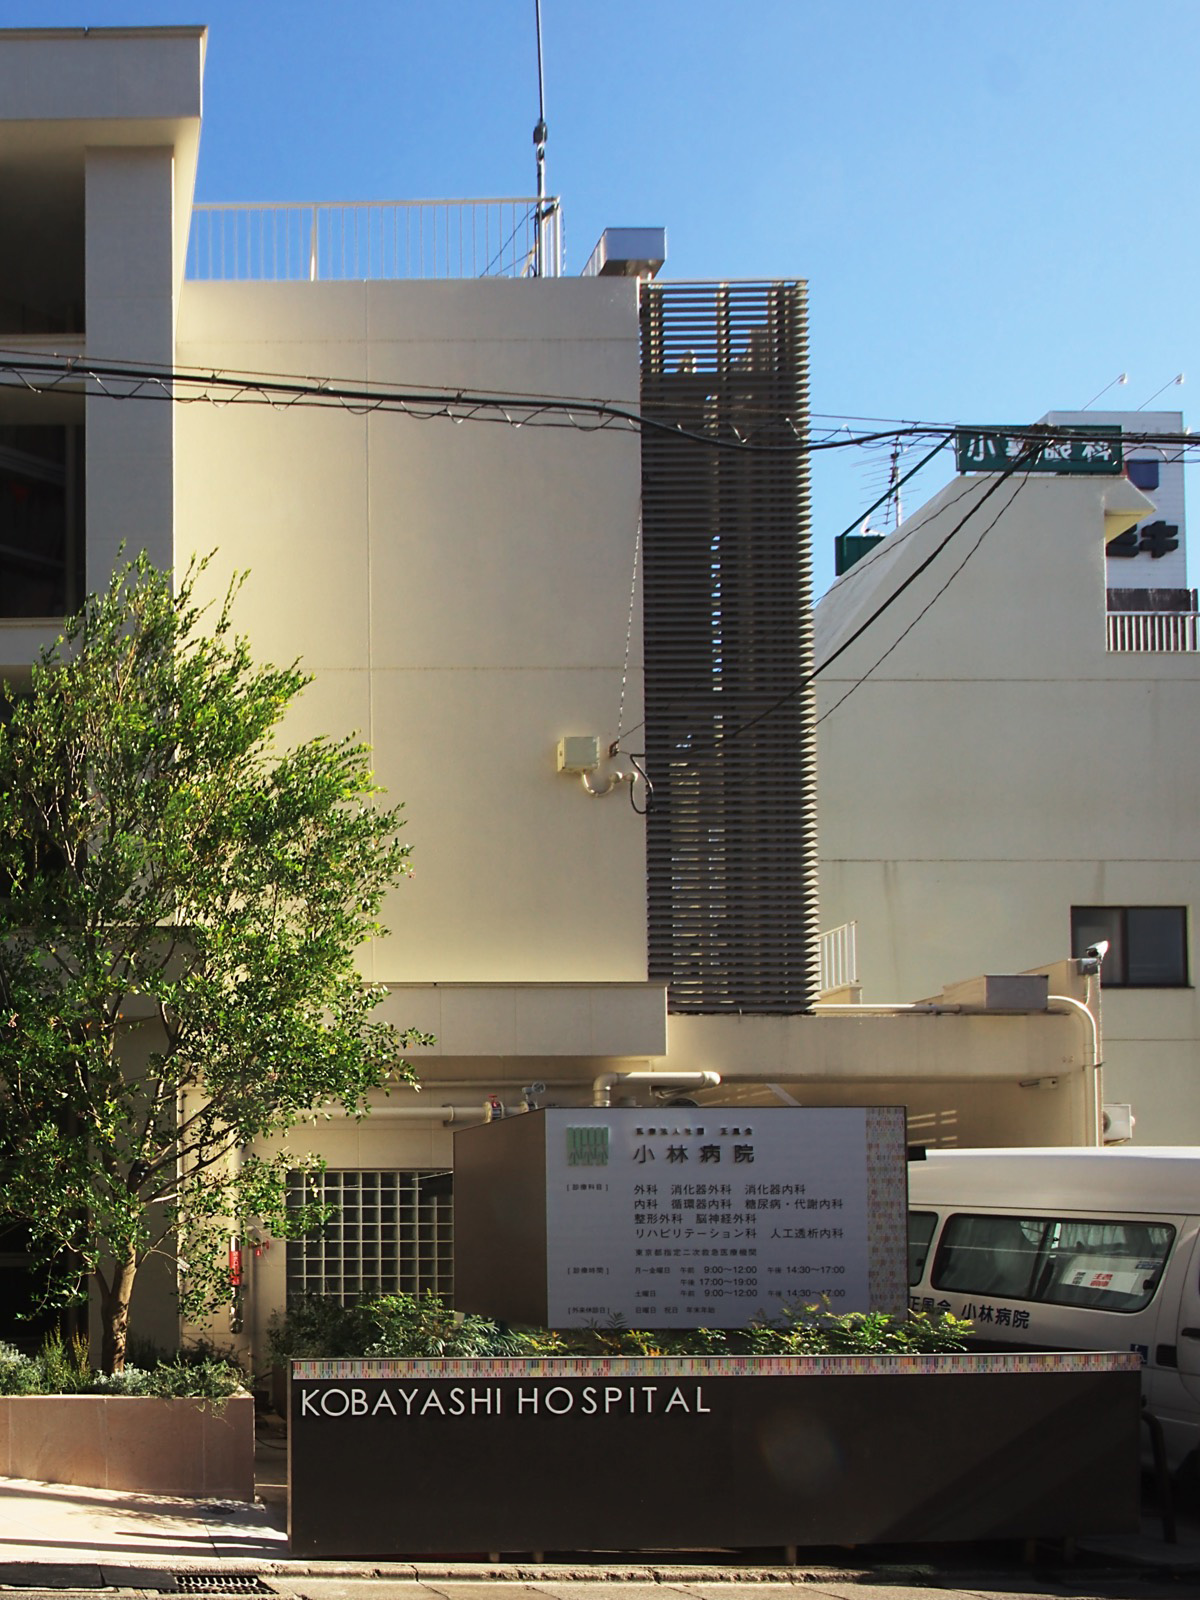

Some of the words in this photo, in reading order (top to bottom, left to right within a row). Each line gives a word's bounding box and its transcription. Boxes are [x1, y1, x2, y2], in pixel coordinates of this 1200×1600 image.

[632, 1144, 755, 1164] 小林病院
[633, 1184, 658, 1196] 外科
[670, 1184, 732, 1196] 消化器外科
[744, 1184, 806, 1196] 消化器内科
[634, 1198, 658, 1210] 内科
[671, 1198, 732, 1210] 循環器内科
[744, 1198, 844, 1210] 糖尿病・代謝内科
[633, 1213, 683, 1225] 整形外科
[695, 1213, 757, 1225] 脳神経外科
[635, 1228, 757, 1239] リハビリテーション科
[769, 1228, 844, 1239] 人工透析内科
[960, 1302, 1031, 1330] 小林病院
[301, 1388, 501, 1417] KOBAYASHI
[518, 1386, 711, 1415] HOSPITAL
